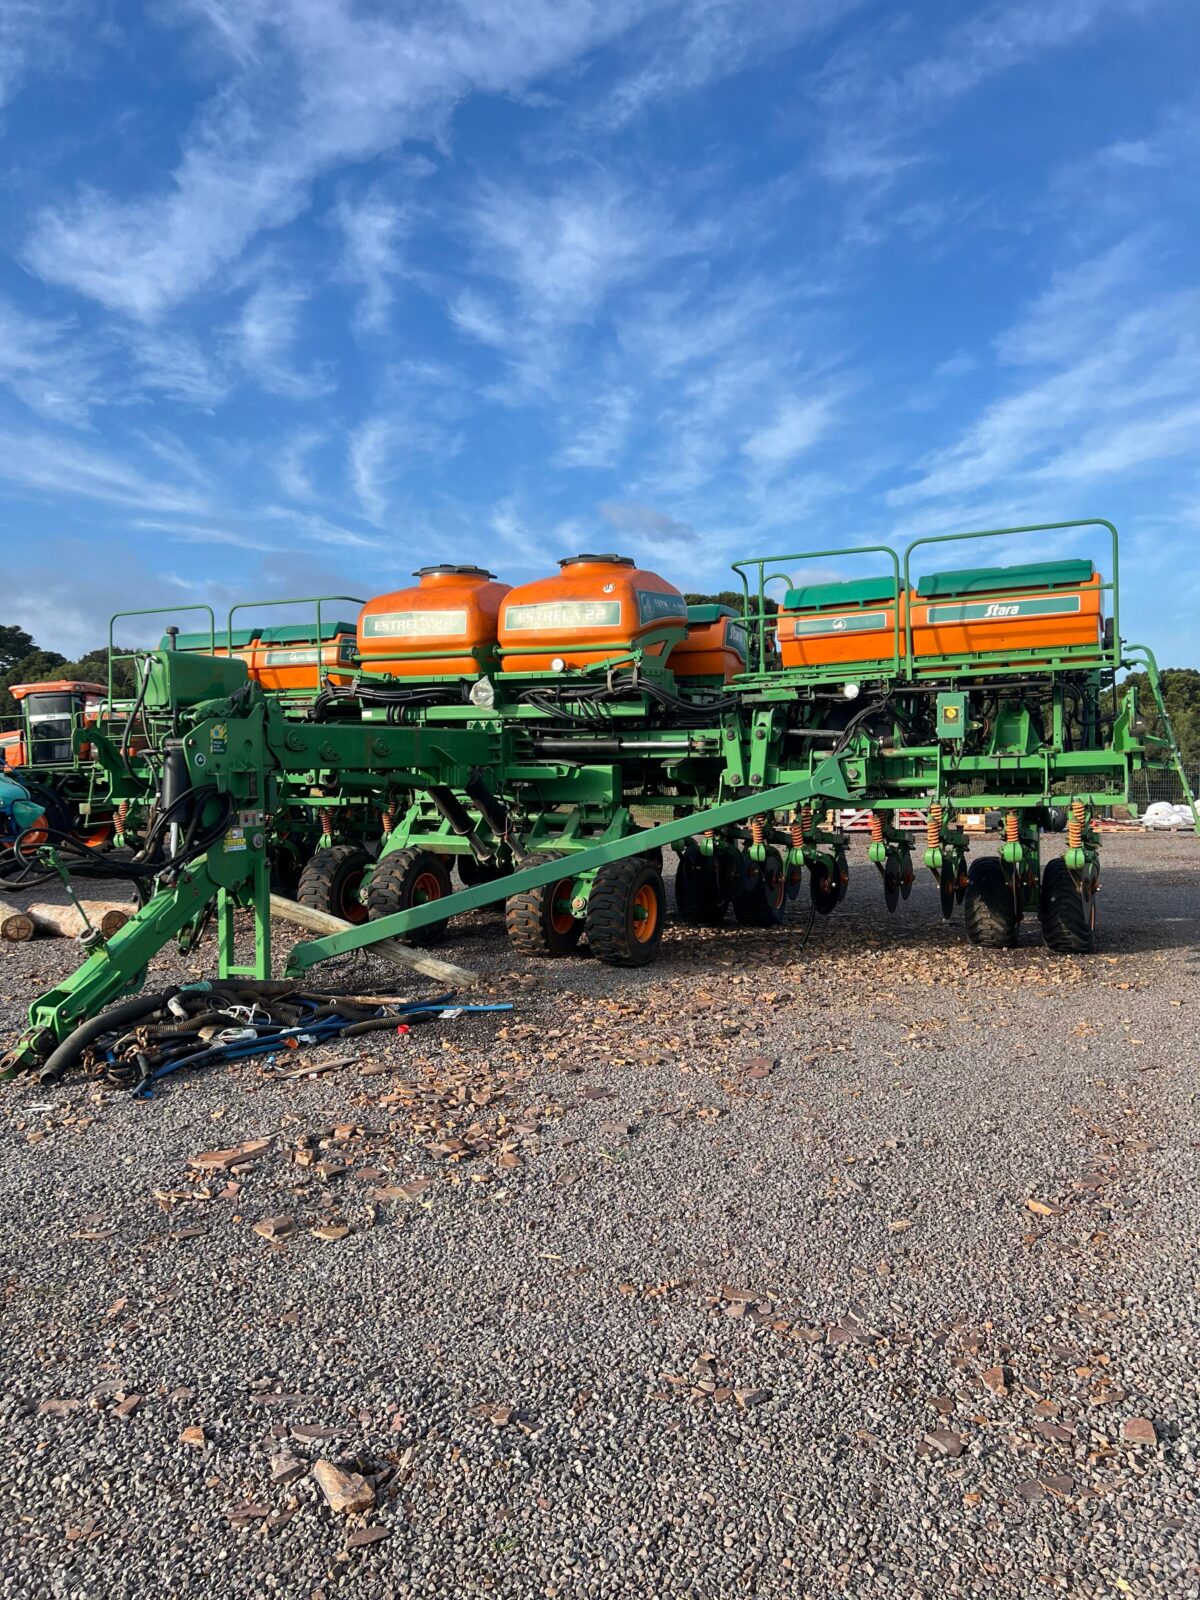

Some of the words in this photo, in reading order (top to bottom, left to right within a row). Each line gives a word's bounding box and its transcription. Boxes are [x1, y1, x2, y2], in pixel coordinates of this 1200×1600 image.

[518, 607, 580, 622] ESTRELA
[585, 605, 607, 620] 22
[984, 604, 1020, 617] Stara
[374, 616, 431, 631] ESTRELA
